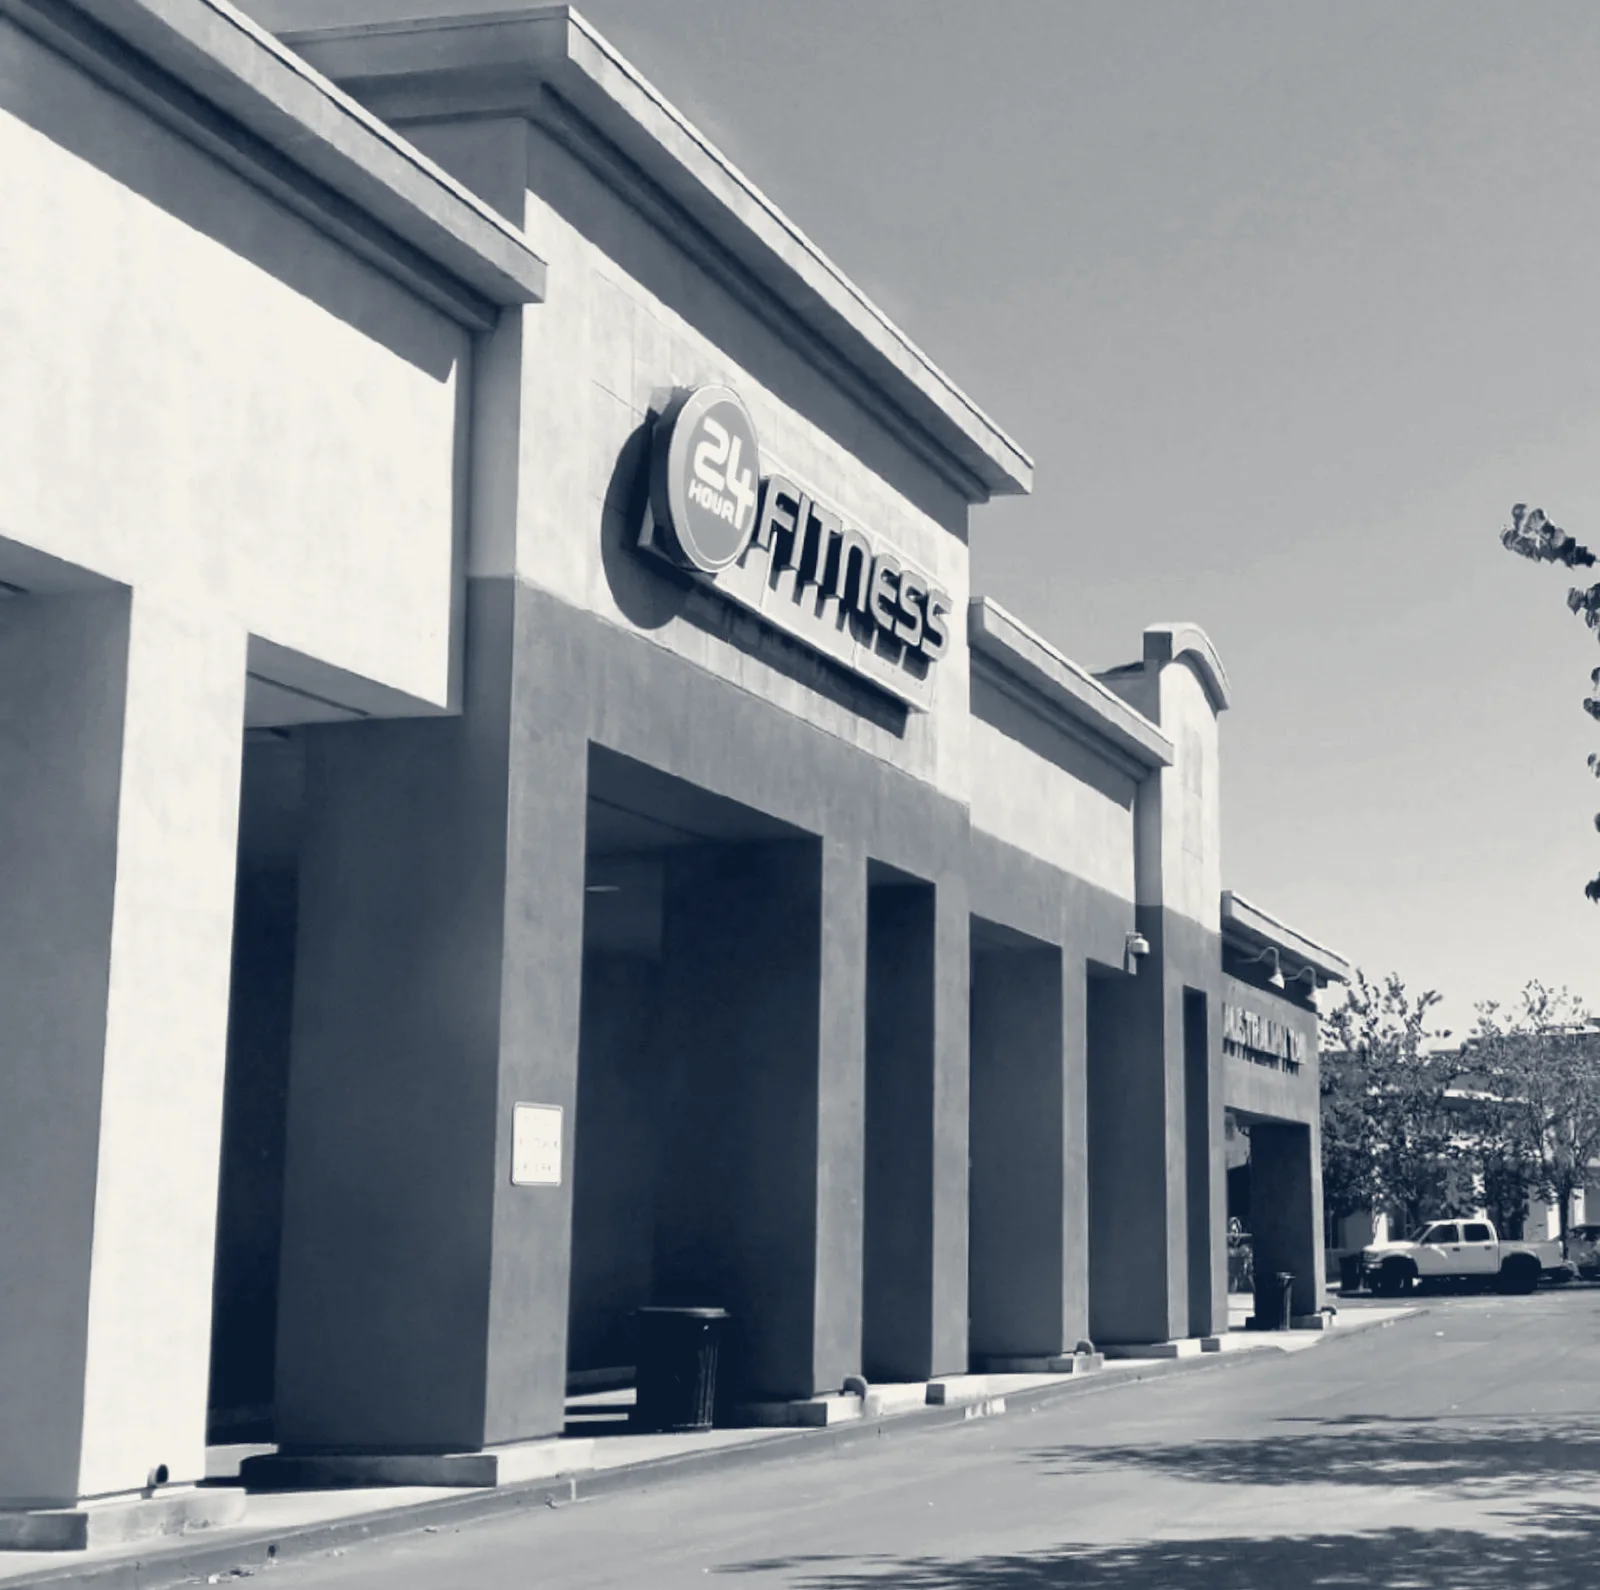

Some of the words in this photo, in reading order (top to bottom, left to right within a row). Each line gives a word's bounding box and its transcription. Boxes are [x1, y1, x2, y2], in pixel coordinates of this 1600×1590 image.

[687, 480, 735, 520] HOUR
[693, 418, 754, 528] 24
[756, 473, 954, 662] FITNESS
